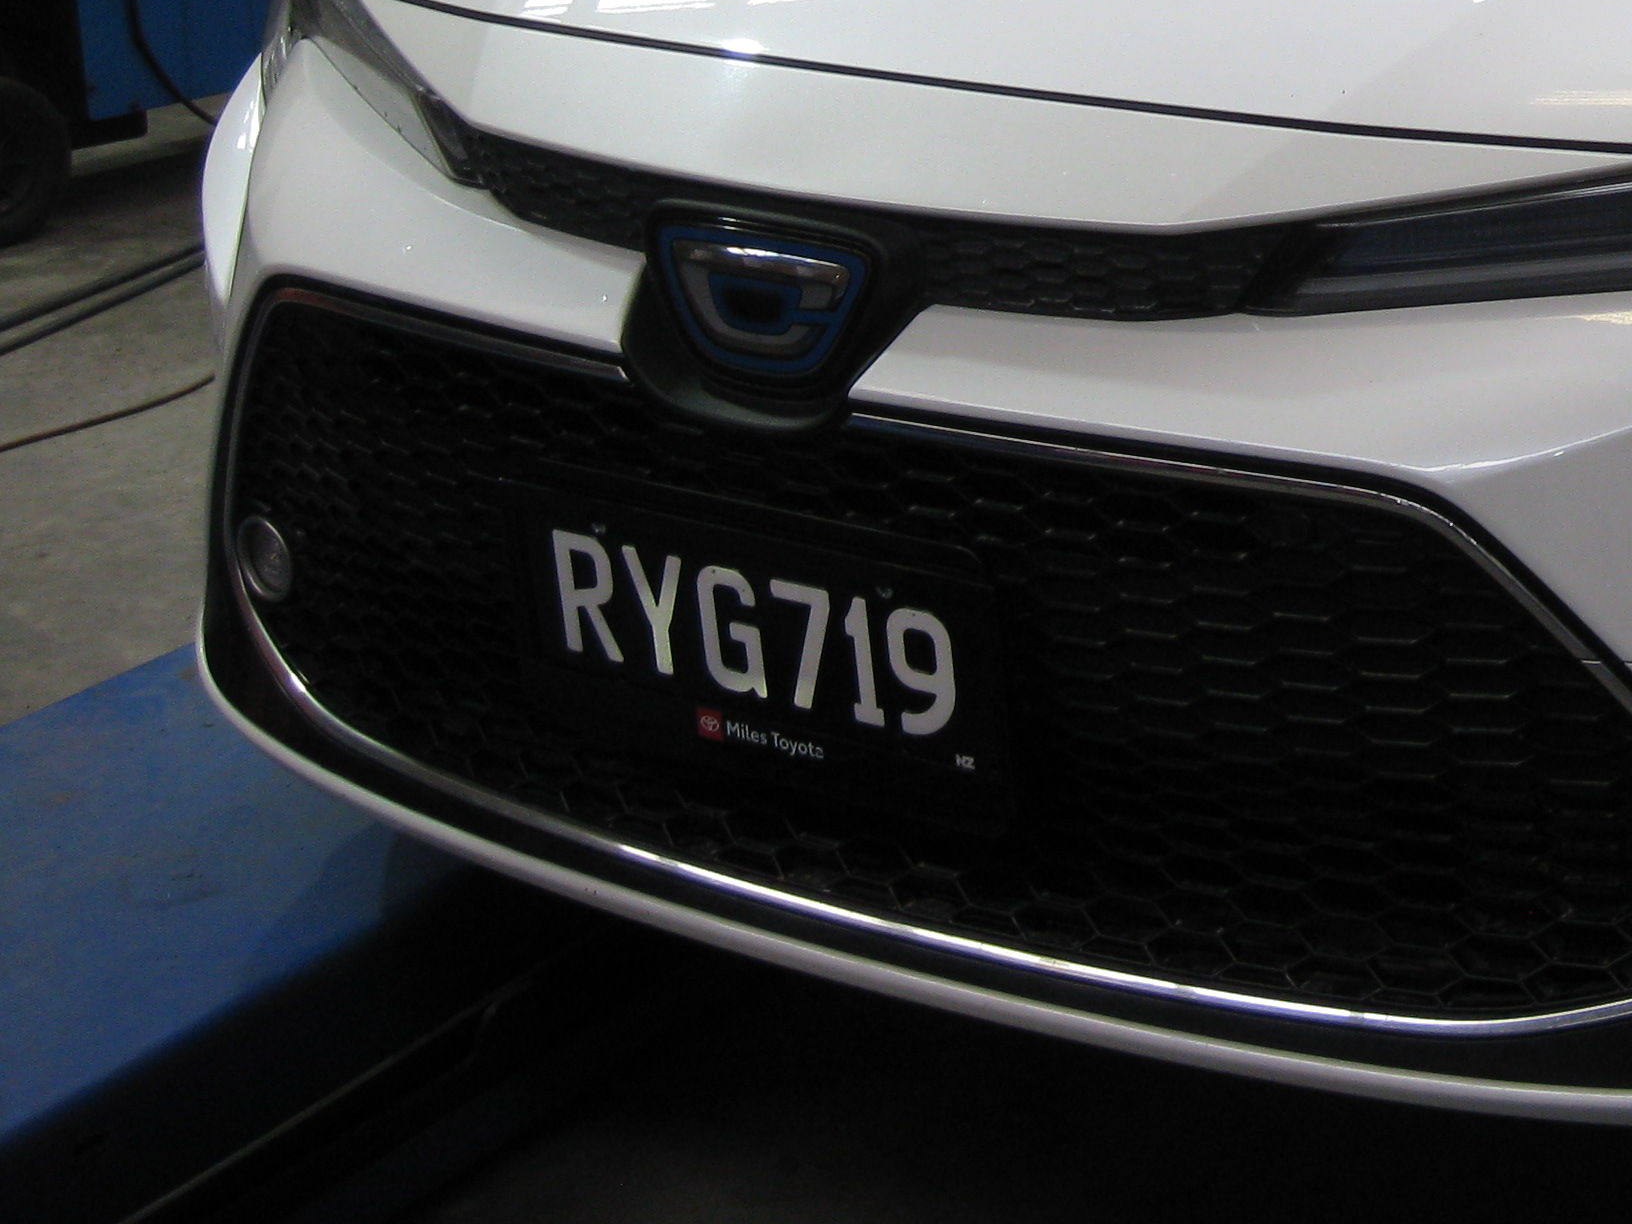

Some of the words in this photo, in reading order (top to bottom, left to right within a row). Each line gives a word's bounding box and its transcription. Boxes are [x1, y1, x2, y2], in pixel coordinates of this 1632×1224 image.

[552, 528, 957, 736] RYG719
[725, 720, 768, 745] Miles
[771, 731, 824, 760] Toyota
